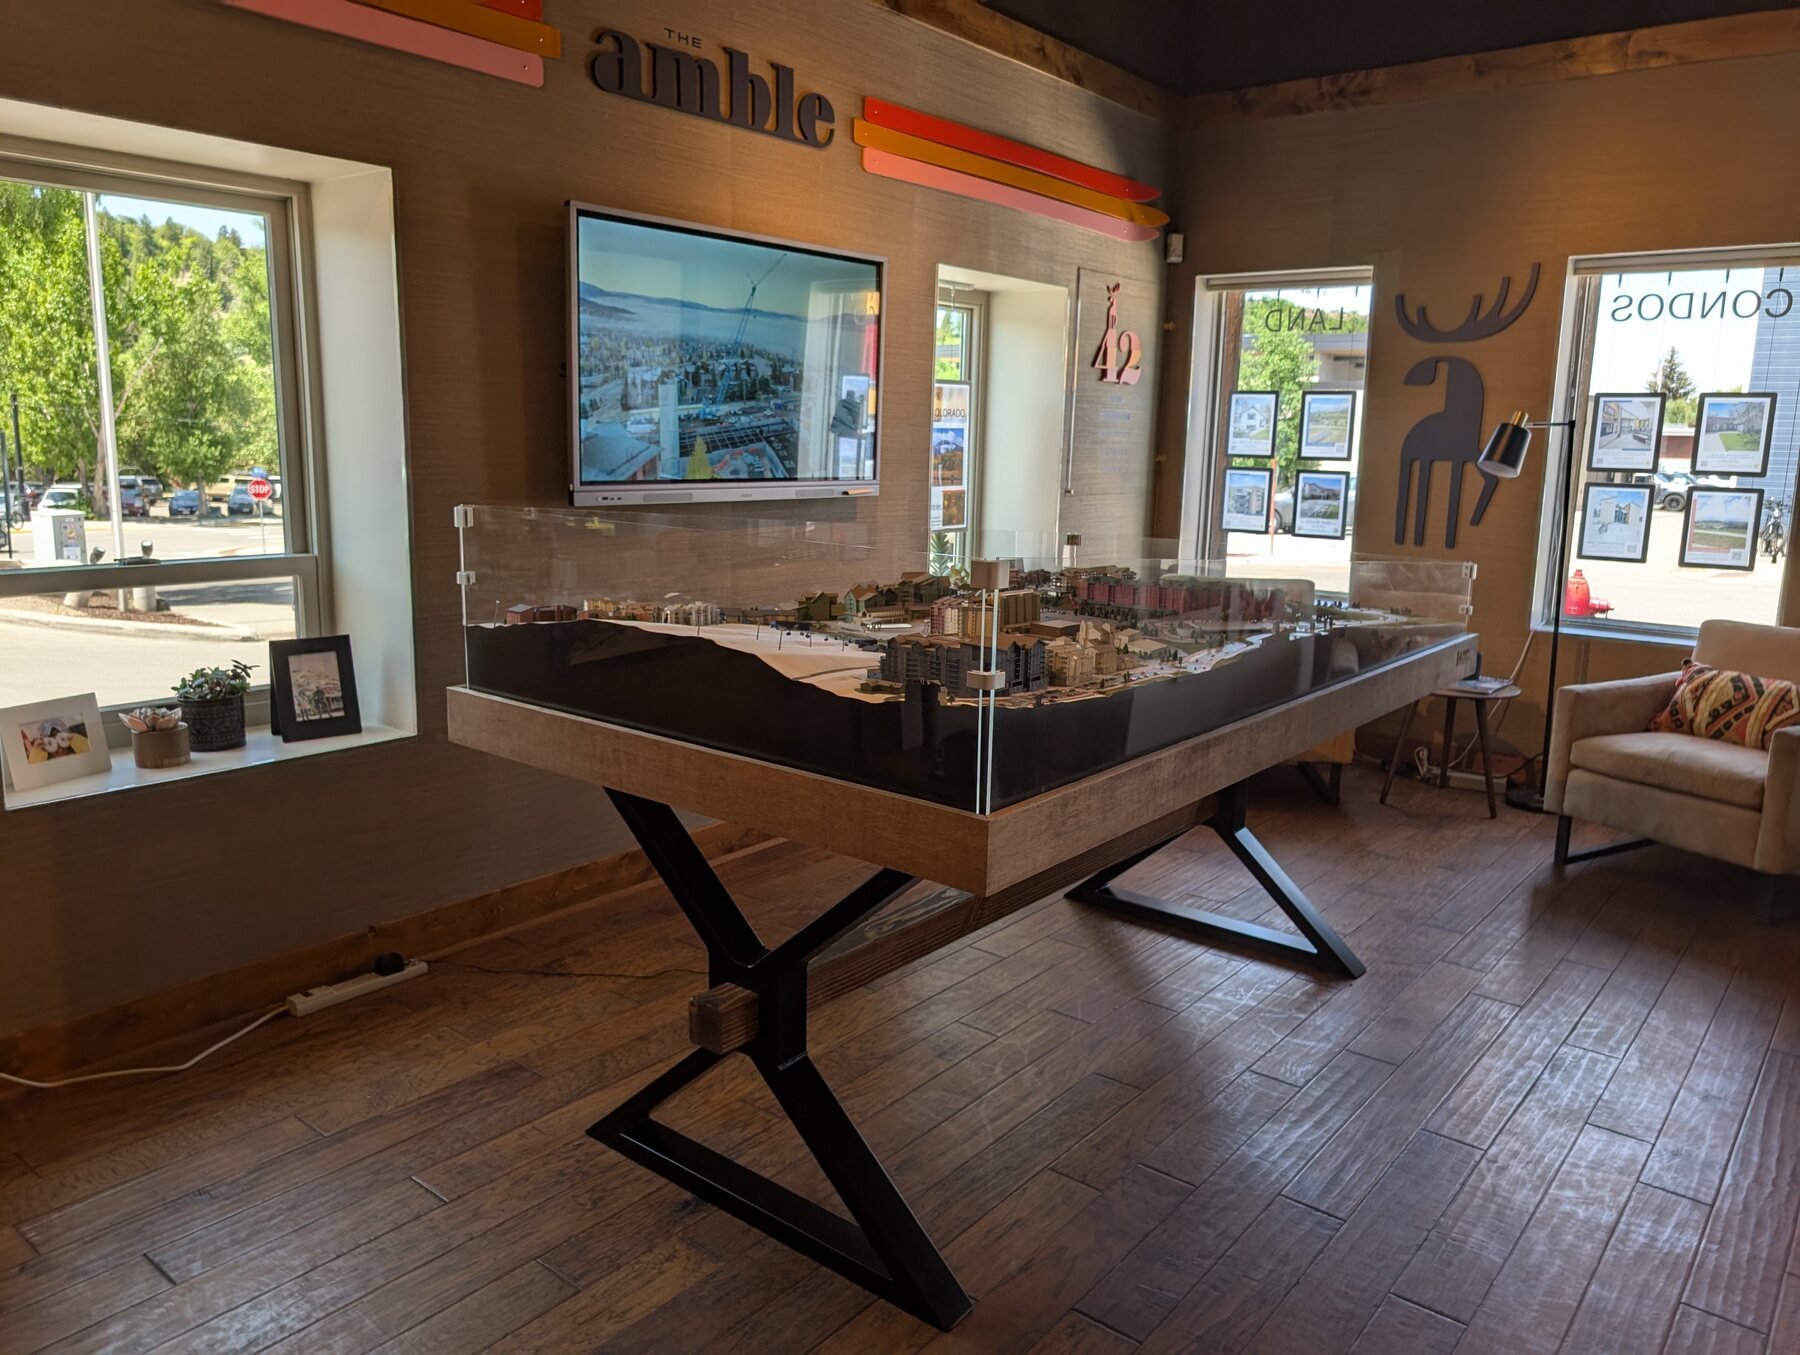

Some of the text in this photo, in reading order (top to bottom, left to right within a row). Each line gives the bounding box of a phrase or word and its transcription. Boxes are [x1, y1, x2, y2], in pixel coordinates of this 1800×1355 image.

[663, 27, 702, 49] THE
[592, 29, 835, 149] amble
[1092, 328, 1142, 385] 42
[250, 483, 270, 495] STOP
